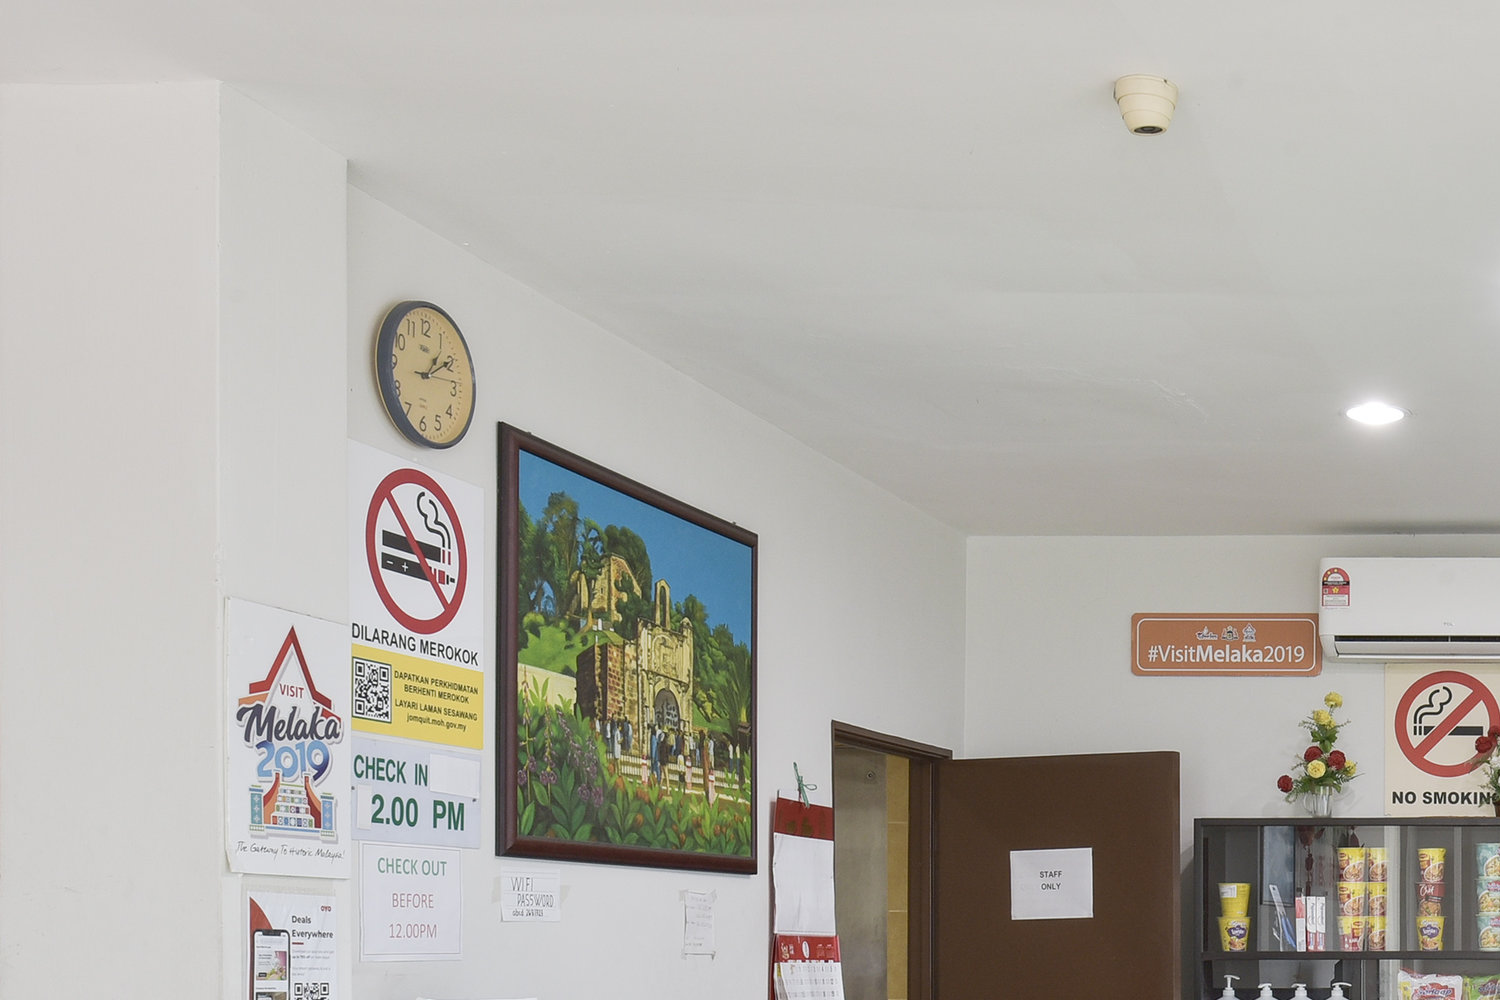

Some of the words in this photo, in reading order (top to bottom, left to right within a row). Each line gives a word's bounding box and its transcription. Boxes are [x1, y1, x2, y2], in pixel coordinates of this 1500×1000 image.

[406, 318, 416, 338] 11
[420, 318, 431, 338] 12
[395, 331, 406, 351] 10
[438, 333, 444, 350] 1
[446, 355, 455, 373] 2
[450, 380, 457, 397] 3
[445, 403, 453, 419] 4
[418, 415, 427, 432] 6
[433, 414, 442, 431] 5
[351, 622, 417, 652] DILARANG
[419, 639, 479, 667] MEROKOK
[1148, 644, 1305, 664] #VisitMelaka2019
[279, 682, 305, 699] VISIT
[394, 669, 429, 685] DAPATKAN
[430, 678, 479, 695] PERKHIDMATAN
[403, 683, 437, 699] BERHENTI
[437, 691, 470, 704] MEROKOK
[394, 698, 418, 711] LAYARI
[419, 703, 442, 716] LAMAN
[443, 707, 478, 721] SESAWANG
[236, 702, 340, 744] Melaka
[406, 713, 467, 733] jomquit.moh.gov.my
[255, 740, 331, 782] 2019
[353, 754, 407, 784] CHECK
[414, 763, 428, 787] IN
[1392, 791, 1416, 805] NO
[371, 793, 419, 828] 2.00
[432, 799, 465, 832] PM
[377, 857, 418, 876] CHECK
[421, 860, 447, 877] OUT
[1039, 870, 1063, 879] STAFF
[510, 876, 534, 892] WIFI
[1040, 882, 1062, 891] ONLY
[392, 893, 435, 909] BEFORE
[517, 893, 555, 908] PASSWORD
[291, 915, 312, 925] Deals
[291, 929, 335, 940] Everywhere
[389, 924, 438, 939] 12.00PM
